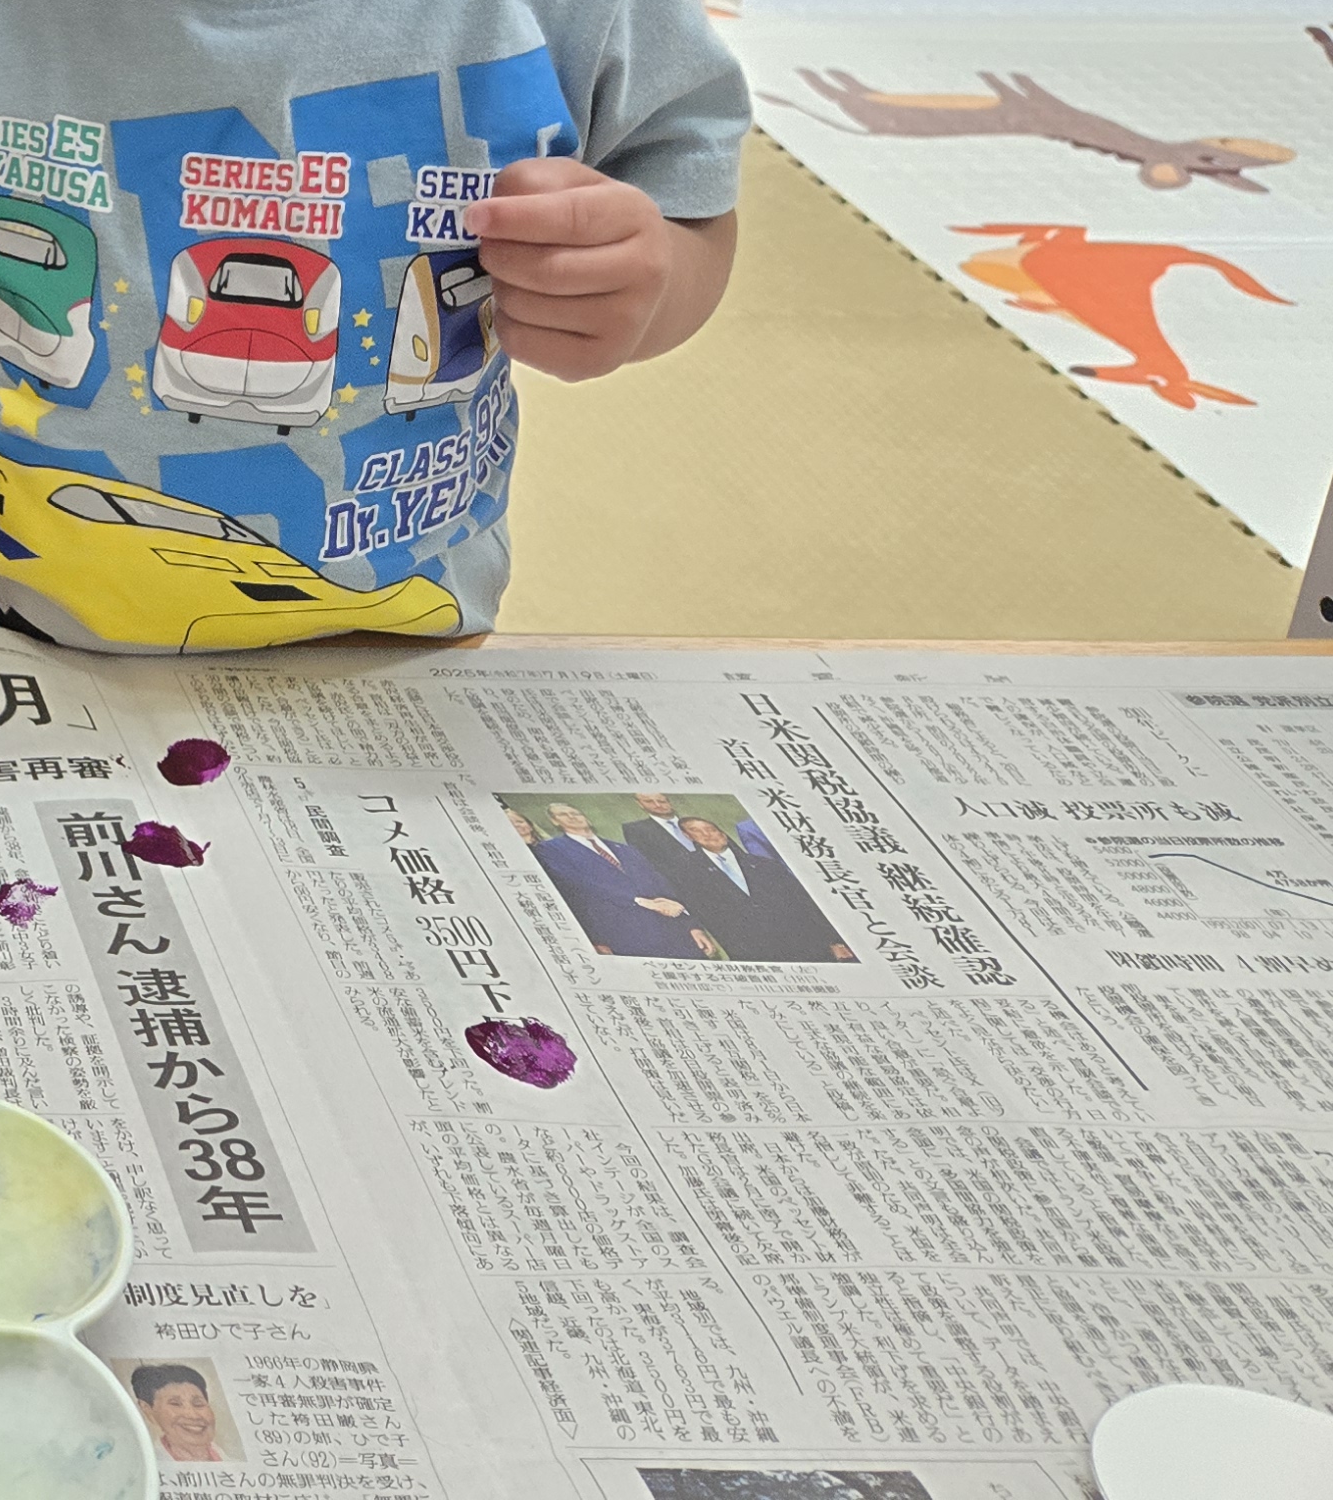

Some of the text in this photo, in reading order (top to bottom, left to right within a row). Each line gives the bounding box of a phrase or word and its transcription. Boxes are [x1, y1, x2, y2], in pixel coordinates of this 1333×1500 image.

[52, 119, 103, 163] E5
[184, 154, 349, 194] SERIES E6
[420, 169, 493, 200] SERI
[184, 197, 342, 236] KOMACHI
[361, 429, 468, 488] CLASS
[305, 805, 349, 857] 民間調査
[740, 693, 909, 855] 日米関税協議
[877, 863, 1018, 986] 継続確認
[1104, 859, 1145, 867] 52000
[1117, 872, 1158, 880] 50000
[1131, 885, 1171, 894] 48000
[1144, 898, 1184, 907] 46000
[358, 794, 525, 1026] コメ価格 3500円下
[1157, 912, 1197, 921] 44000
[117, 968, 283, 1234] 逮捕から38年
[155, 1322, 311, 1341] 袴田ひで子さん
